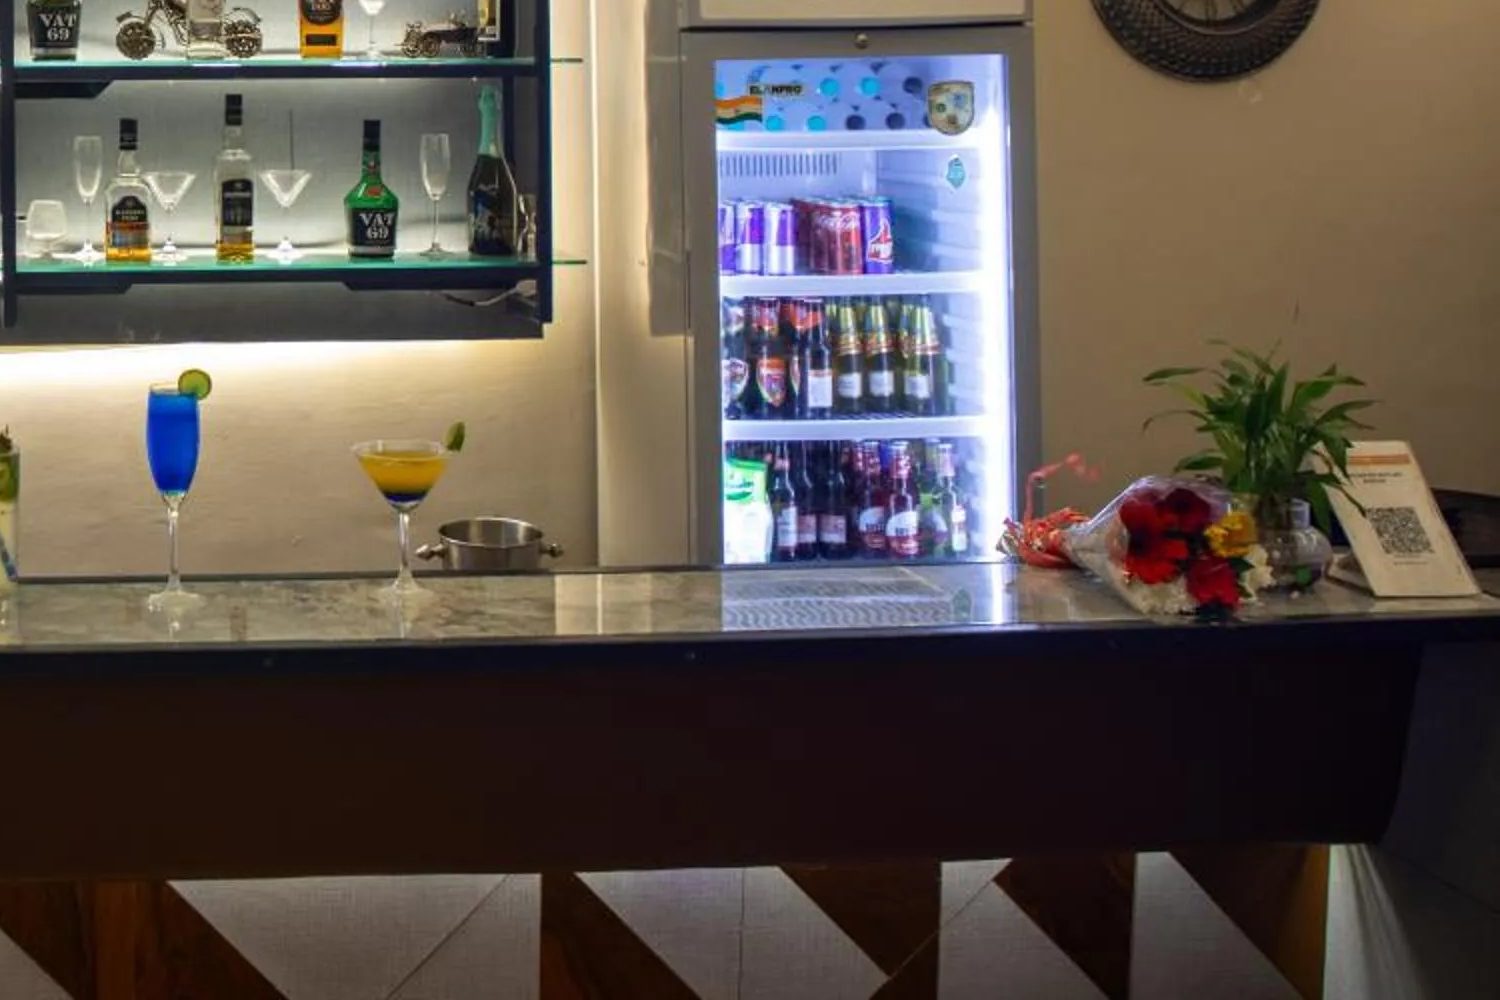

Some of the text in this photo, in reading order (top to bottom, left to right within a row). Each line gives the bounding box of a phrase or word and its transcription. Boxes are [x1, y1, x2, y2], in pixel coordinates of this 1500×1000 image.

[38, 13, 78, 28] VAT
[46, 27, 71, 41] 69
[359, 212, 396, 227] VAT
[366, 226, 390, 240] 69
